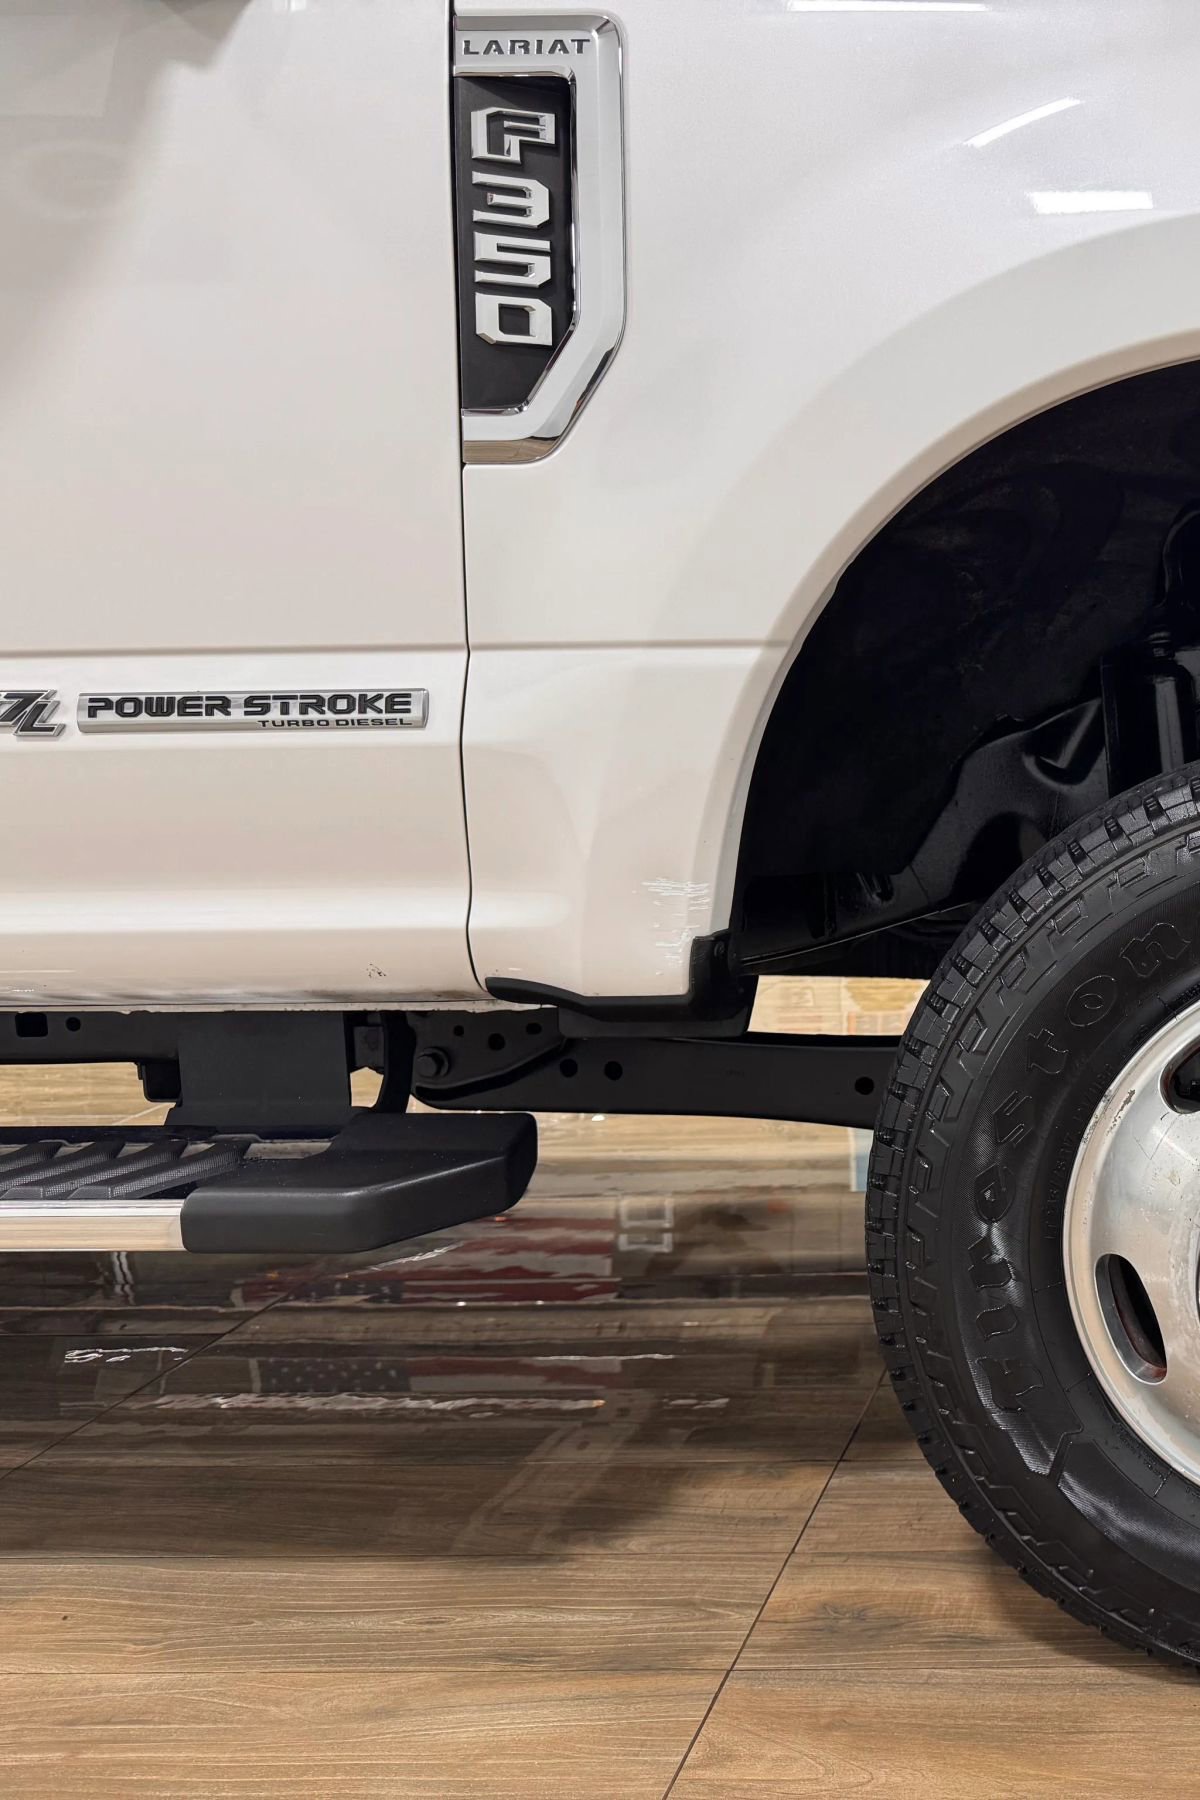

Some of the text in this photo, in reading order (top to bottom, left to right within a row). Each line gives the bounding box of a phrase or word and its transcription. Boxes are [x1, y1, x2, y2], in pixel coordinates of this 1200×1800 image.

[462, 38, 591, 56] LARIAT
[470, 106, 556, 347] F350
[87, 692, 413, 719] POWER STROKE
[257, 717, 413, 729] TURBO DIESEL
